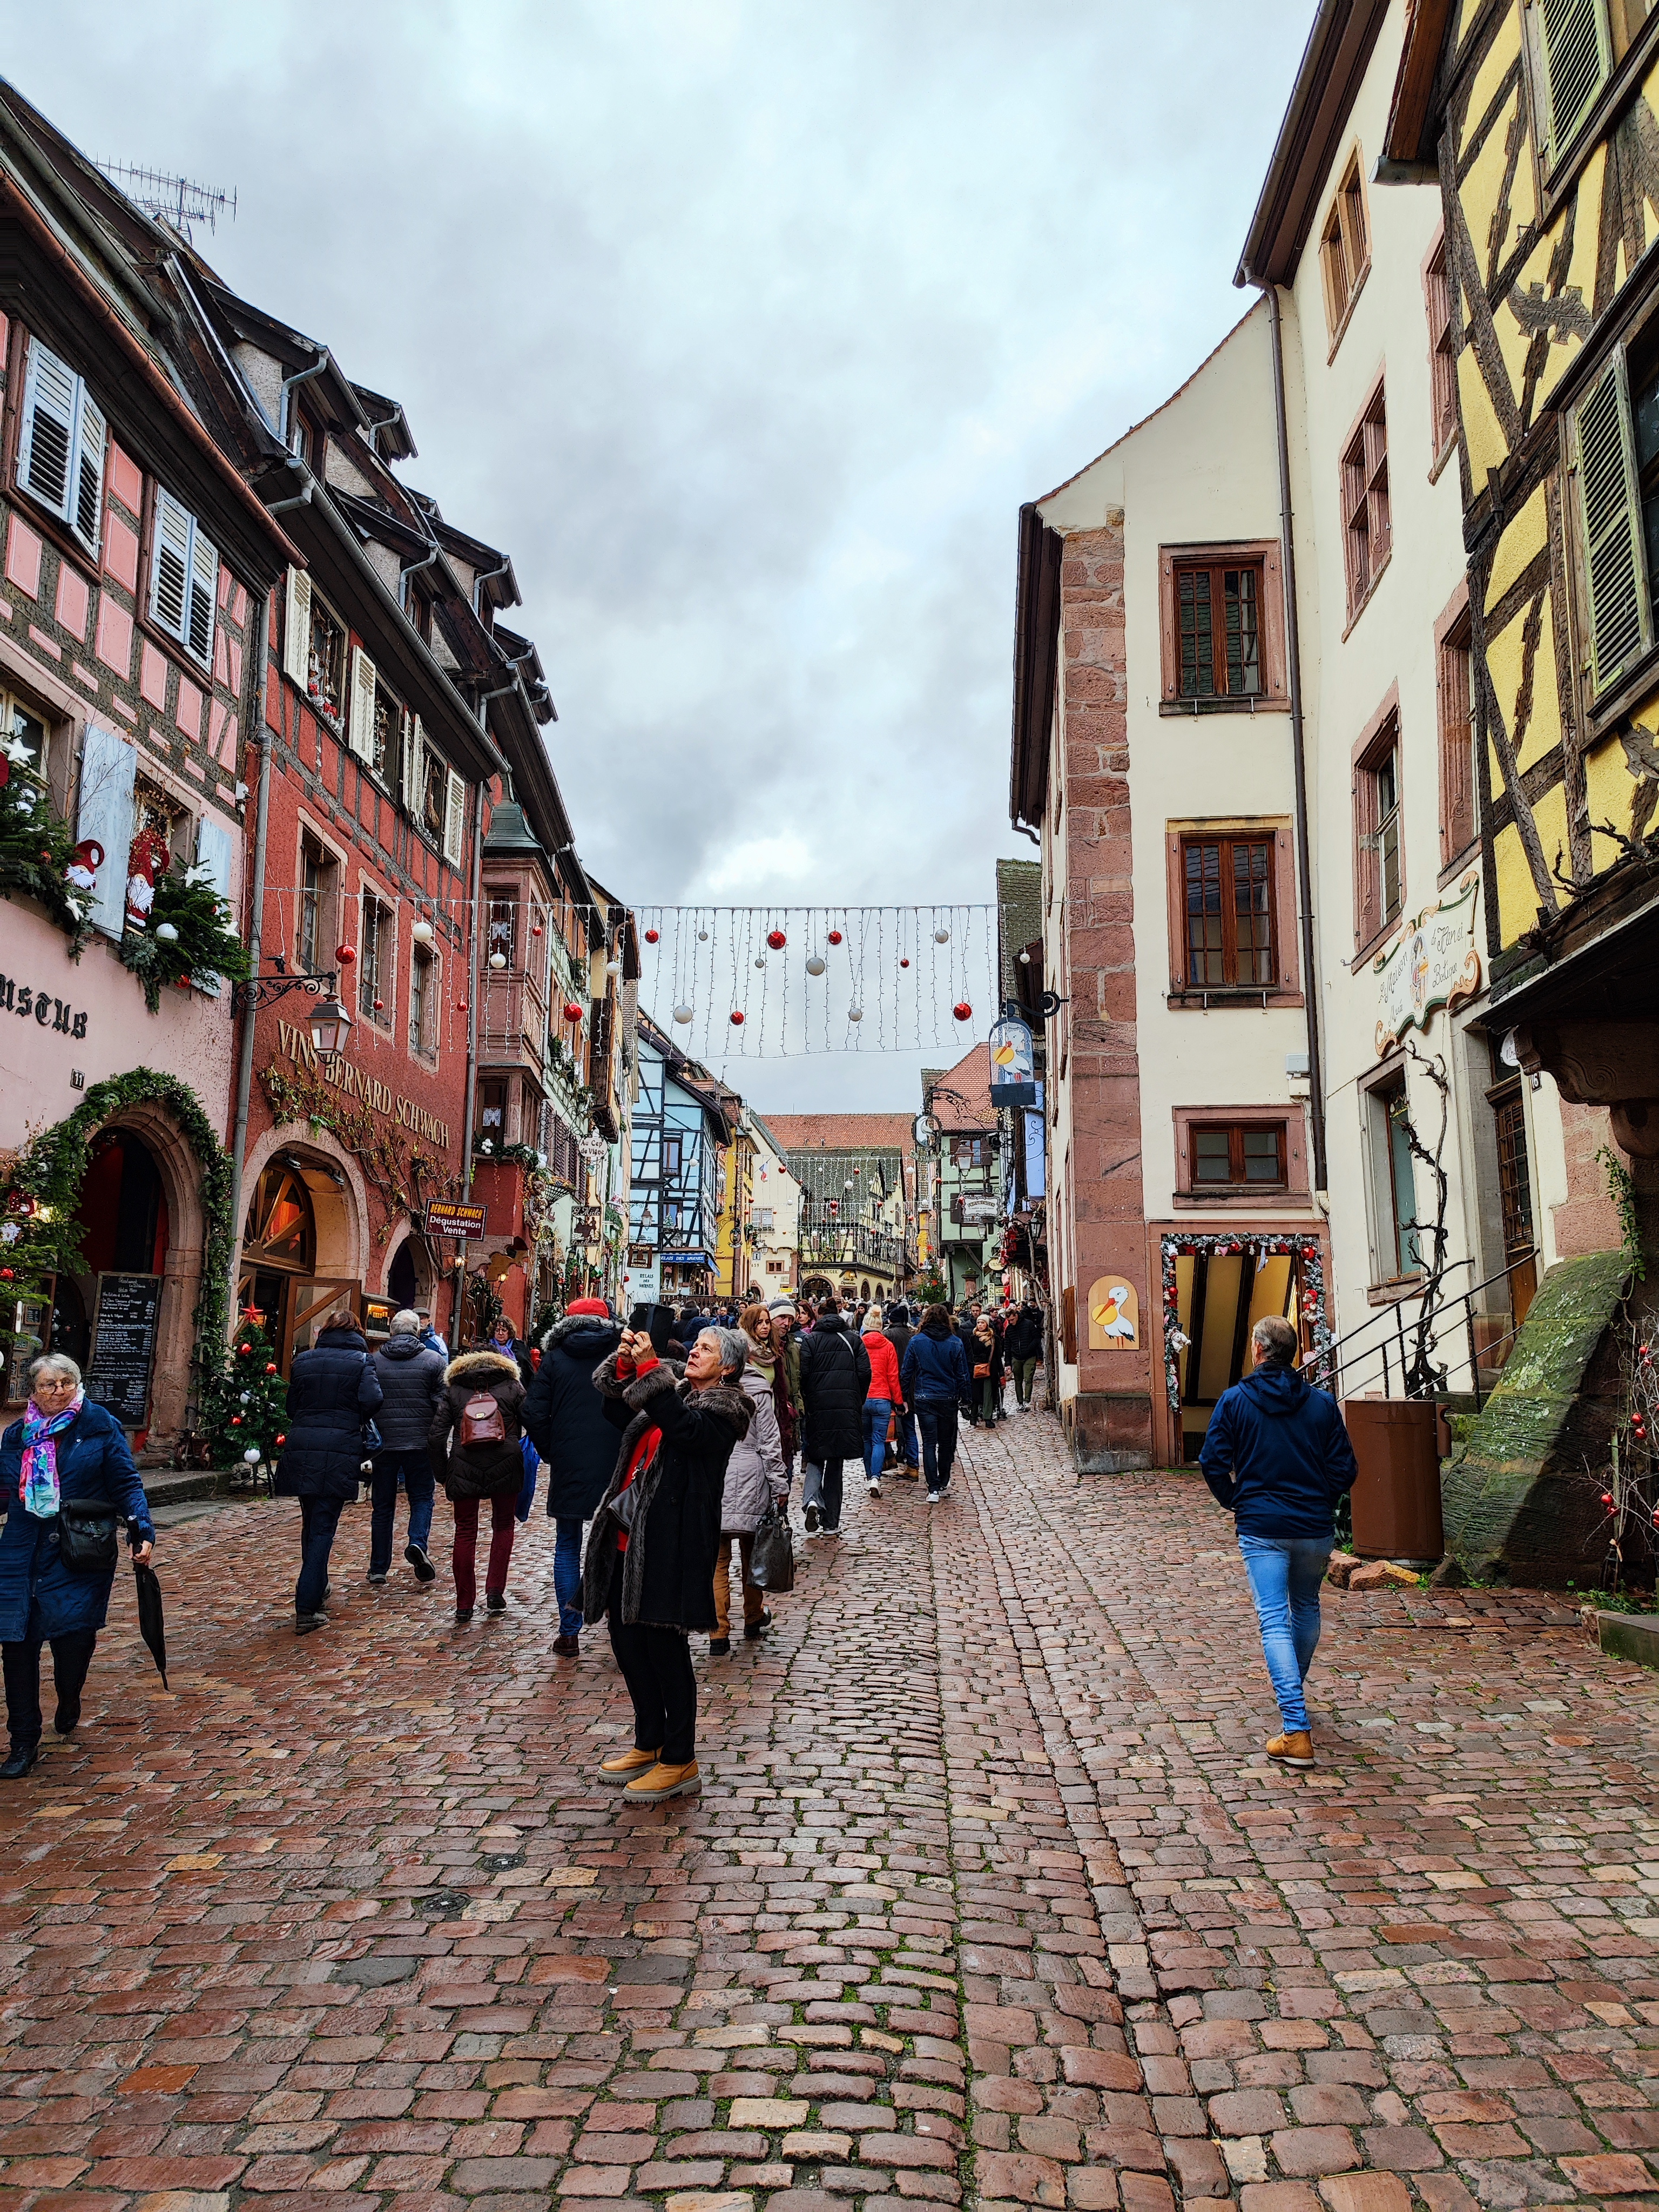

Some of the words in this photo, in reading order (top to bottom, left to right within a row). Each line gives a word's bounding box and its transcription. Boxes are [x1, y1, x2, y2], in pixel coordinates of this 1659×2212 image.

[1385, 952, 1408, 1003] Maison
[1431, 928, 1437, 945] de
[1437, 922, 1464, 954] Hansi
[75, 1073, 83, 1087] 11
[277, 1019, 319, 1071] VINS
[325, 1053, 392, 1115] BERNARD
[396, 1095, 449, 1149] SCHWACH
[1530, 1073, 1539, 1088] 16
[591, 1140, 603, 1148] Cep
[913, 1152, 943, 1162] RESTAURANT
[457, 1206, 483, 1219] SCHWACH
[430, 1216, 481, 1229] Dégustation
[443, 1226, 467, 1235] Vente
